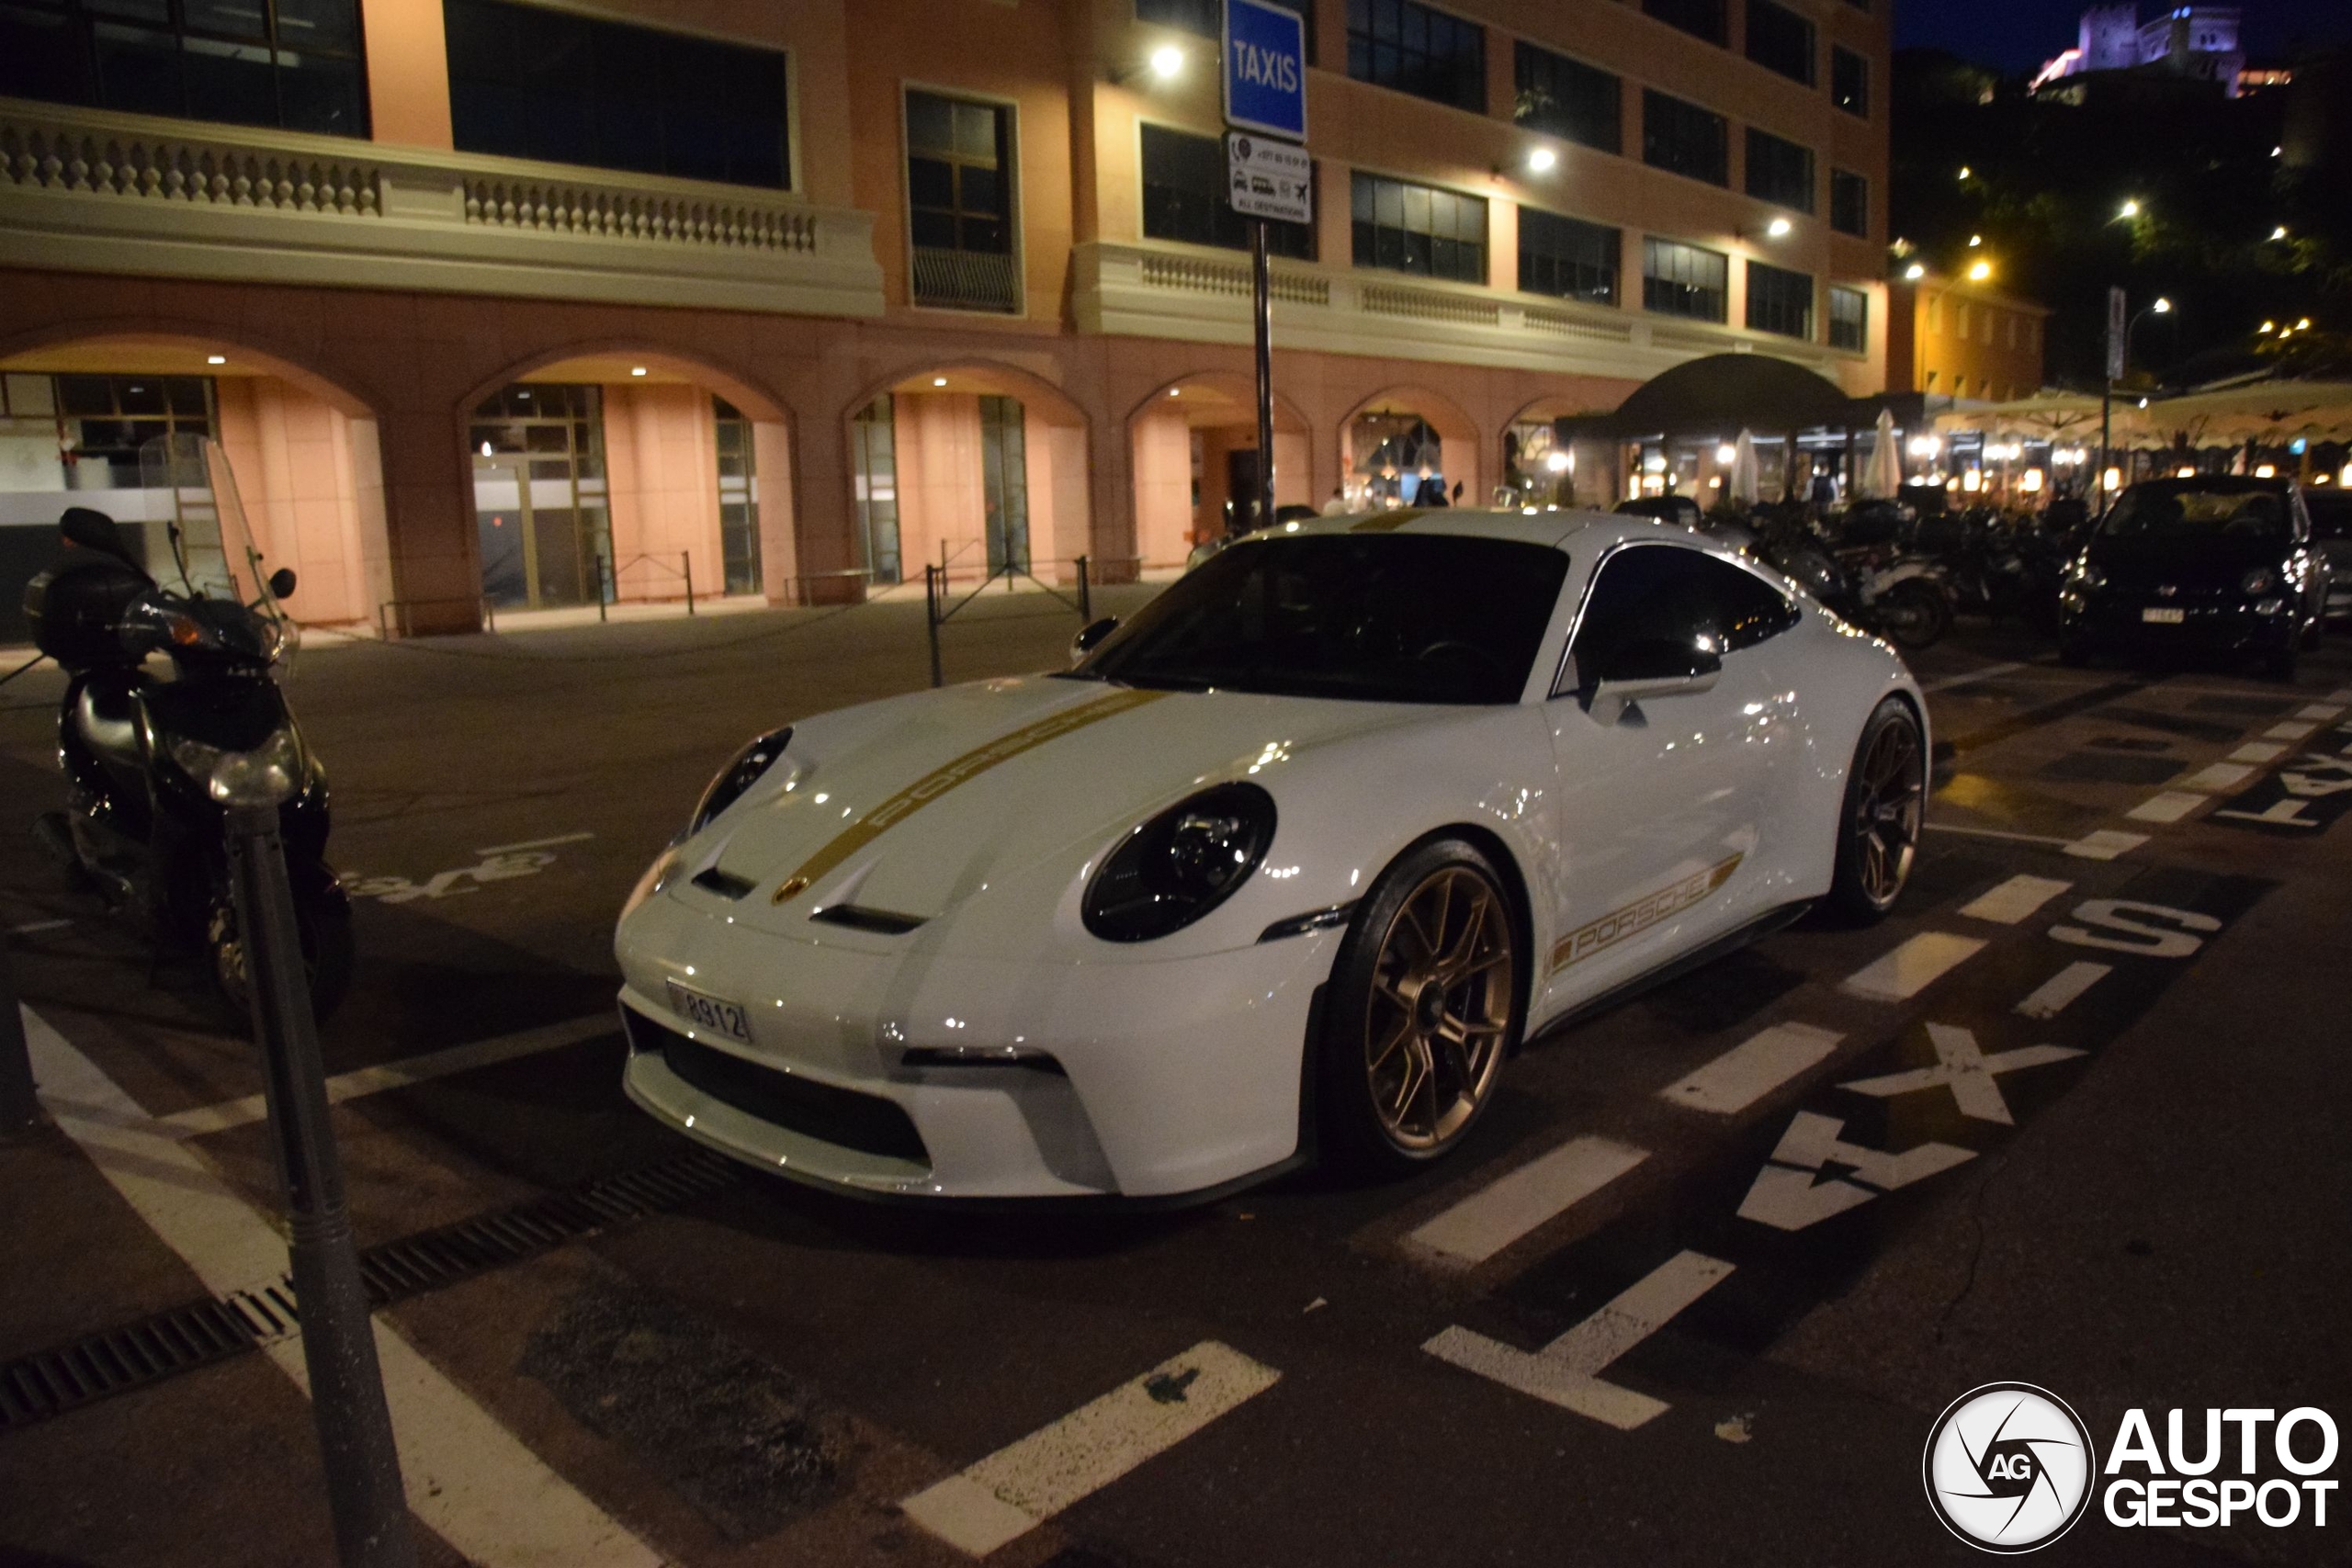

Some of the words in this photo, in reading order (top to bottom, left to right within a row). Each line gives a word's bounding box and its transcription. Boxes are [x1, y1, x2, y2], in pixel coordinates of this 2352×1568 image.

[1232, 39, 1297, 95] TAXIS
[1576, 874, 1705, 955] PORSCHE
[685, 993, 745, 1039] 8912
[1419, 897, 2223, 1431] TAXIS
